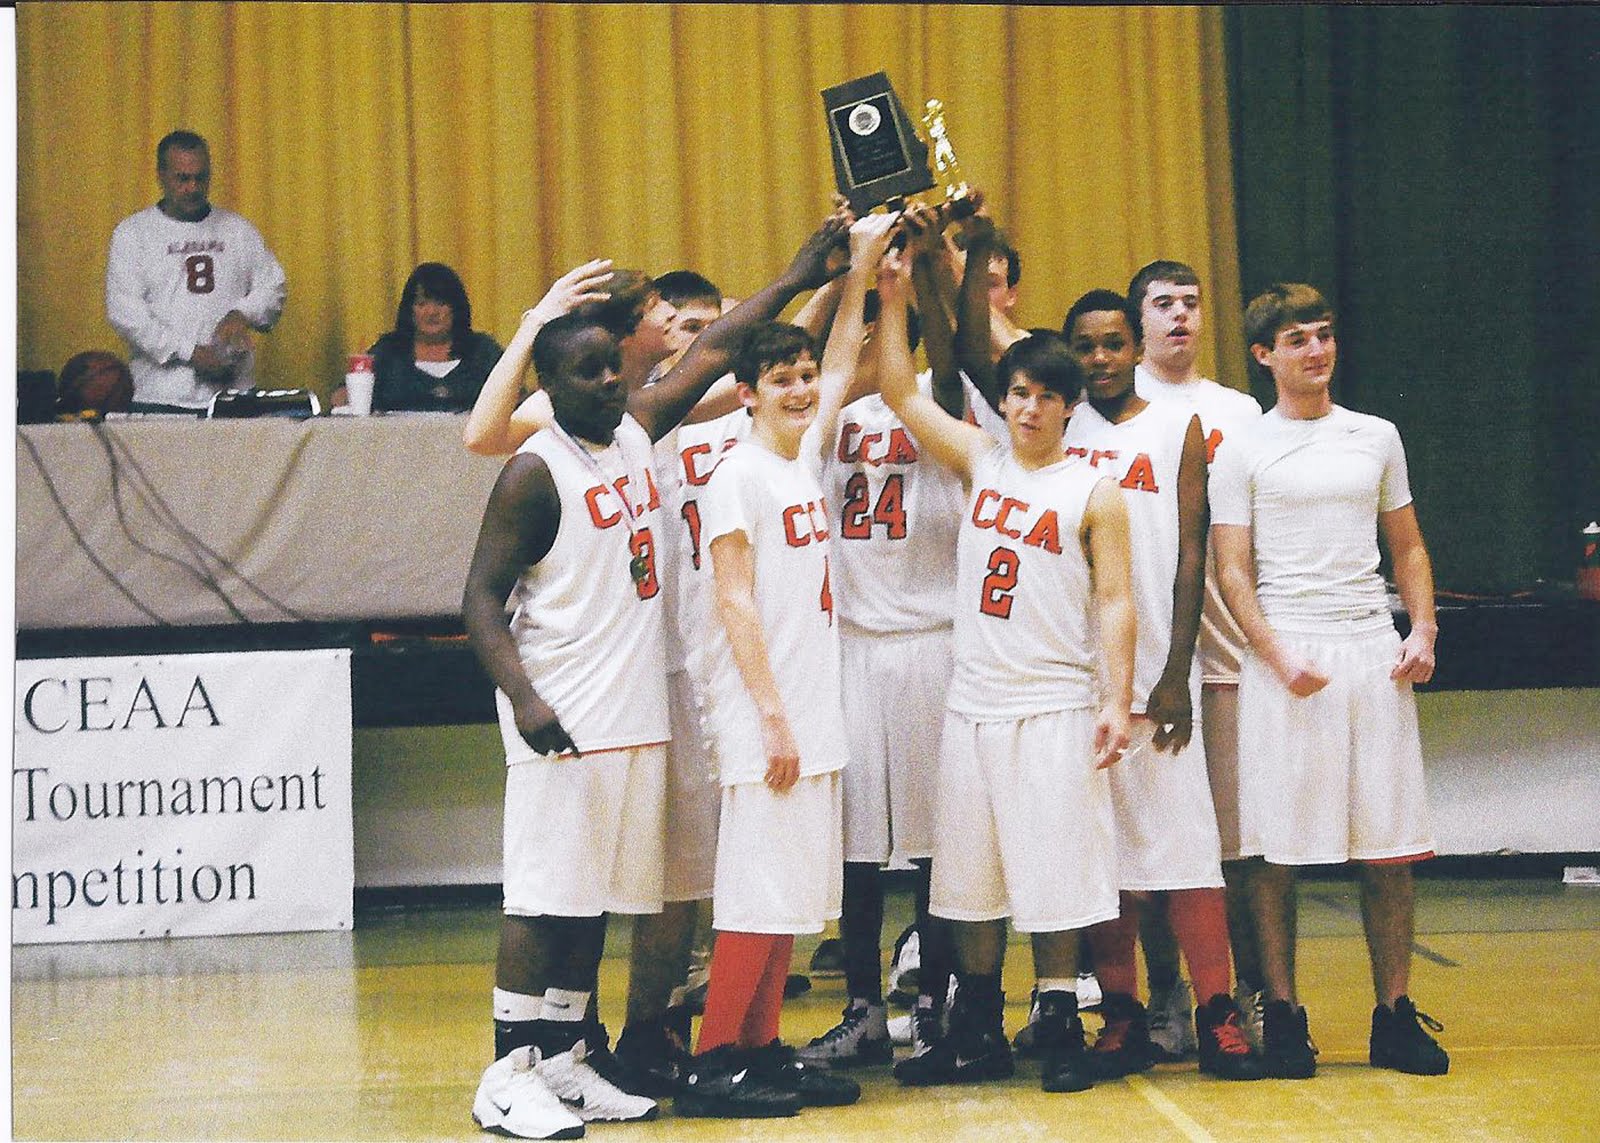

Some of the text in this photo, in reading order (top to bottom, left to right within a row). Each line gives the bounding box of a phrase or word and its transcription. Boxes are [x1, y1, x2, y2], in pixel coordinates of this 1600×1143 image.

[185, 255, 215, 294] 8
[838, 422, 918, 467] CCA
[841, 472, 907, 540] 24
[972, 488, 1062, 556] CCA
[980, 546, 1021, 620] 2
[23, 675, 221, 734] CEAA
[12, 765, 327, 821] Tournament
